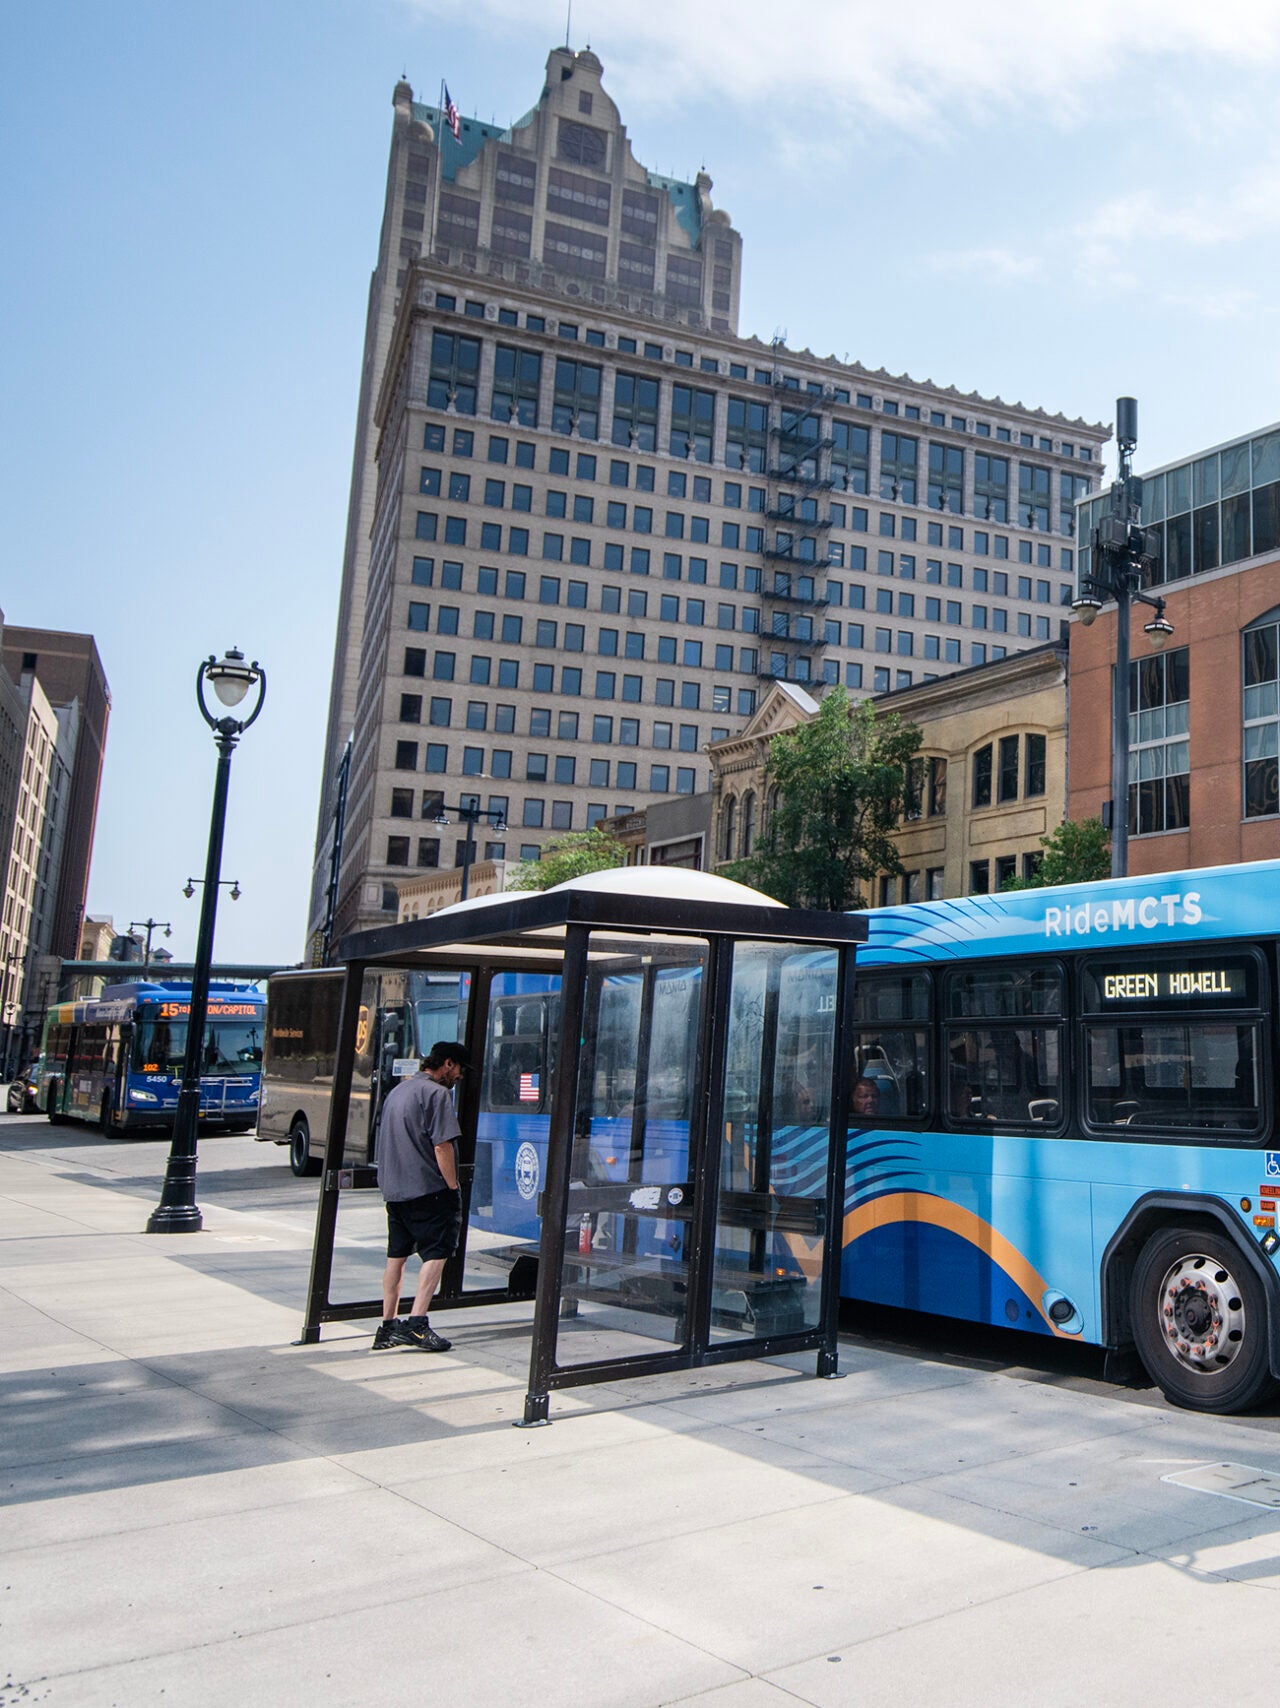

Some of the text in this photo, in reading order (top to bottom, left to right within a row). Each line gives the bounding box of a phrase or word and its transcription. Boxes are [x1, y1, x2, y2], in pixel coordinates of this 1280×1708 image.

[1044, 891, 1203, 938] RideMCTS
[1104, 971, 1232, 998] GREEN HOWELL
[160, 1003, 179, 1017] 15
[146, 1075, 168, 1083] 5450
